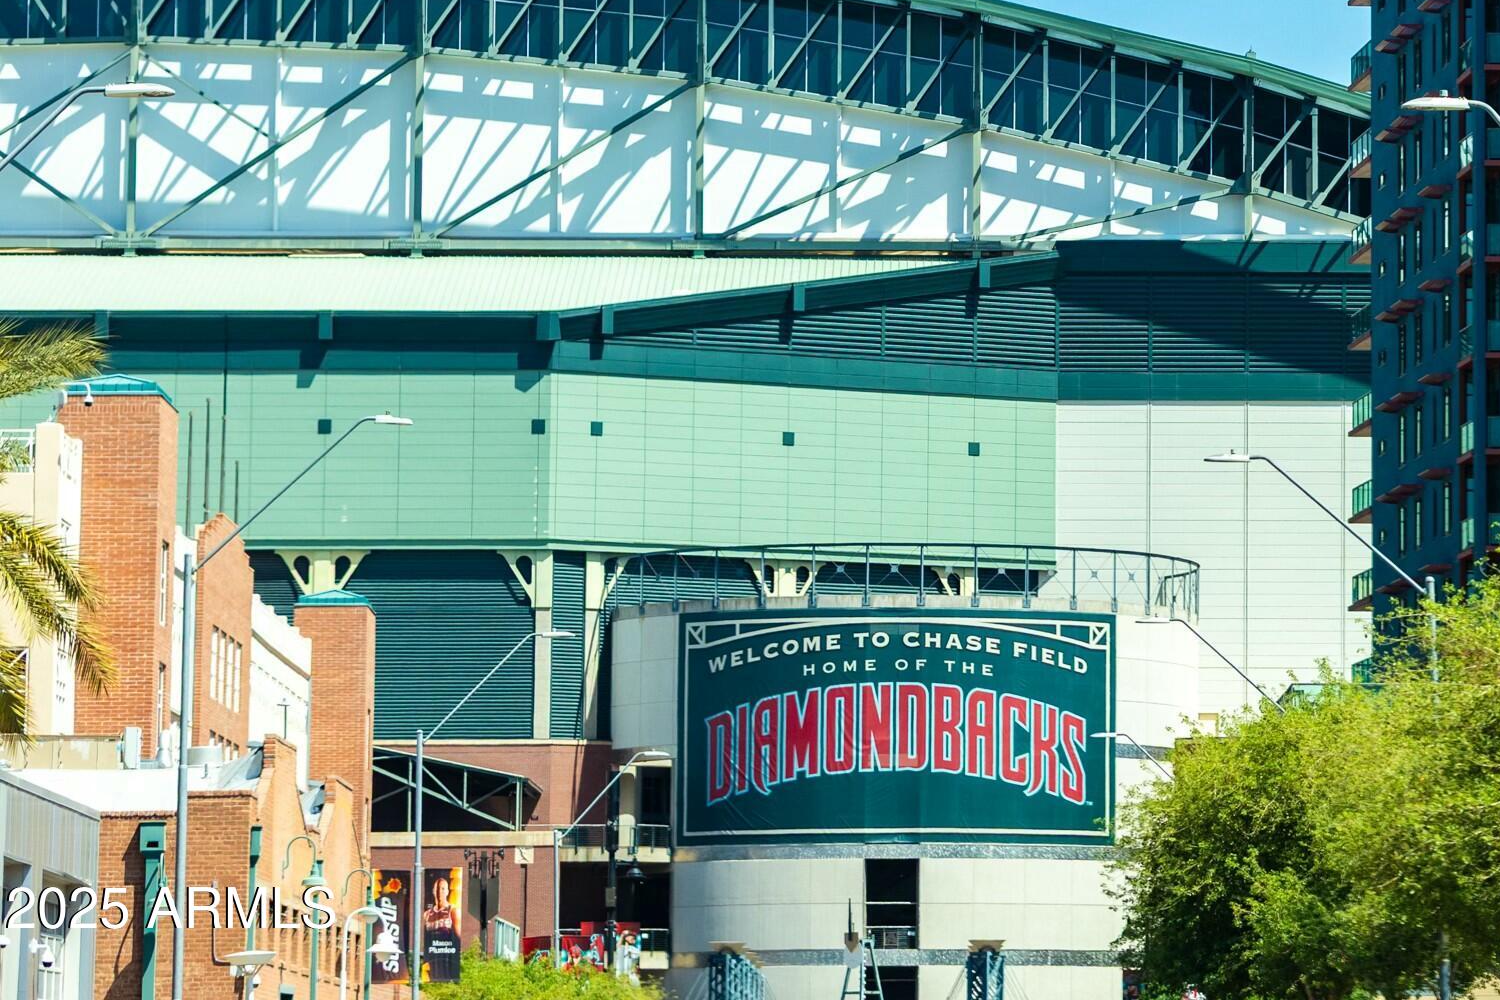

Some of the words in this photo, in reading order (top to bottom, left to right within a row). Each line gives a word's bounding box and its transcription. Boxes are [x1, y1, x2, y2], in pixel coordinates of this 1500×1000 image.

[708, 633, 841, 673] WELCOME
[853, 631, 890, 648] TO
[902, 631, 1000, 655] CHASE
[1013, 641, 1088, 674] FIELD
[803, 659, 876, 676] HOME
[894, 659, 927, 671] OF
[944, 660, 994, 677] THE
[705, 682, 1086, 807] DIAMONDBACKS
